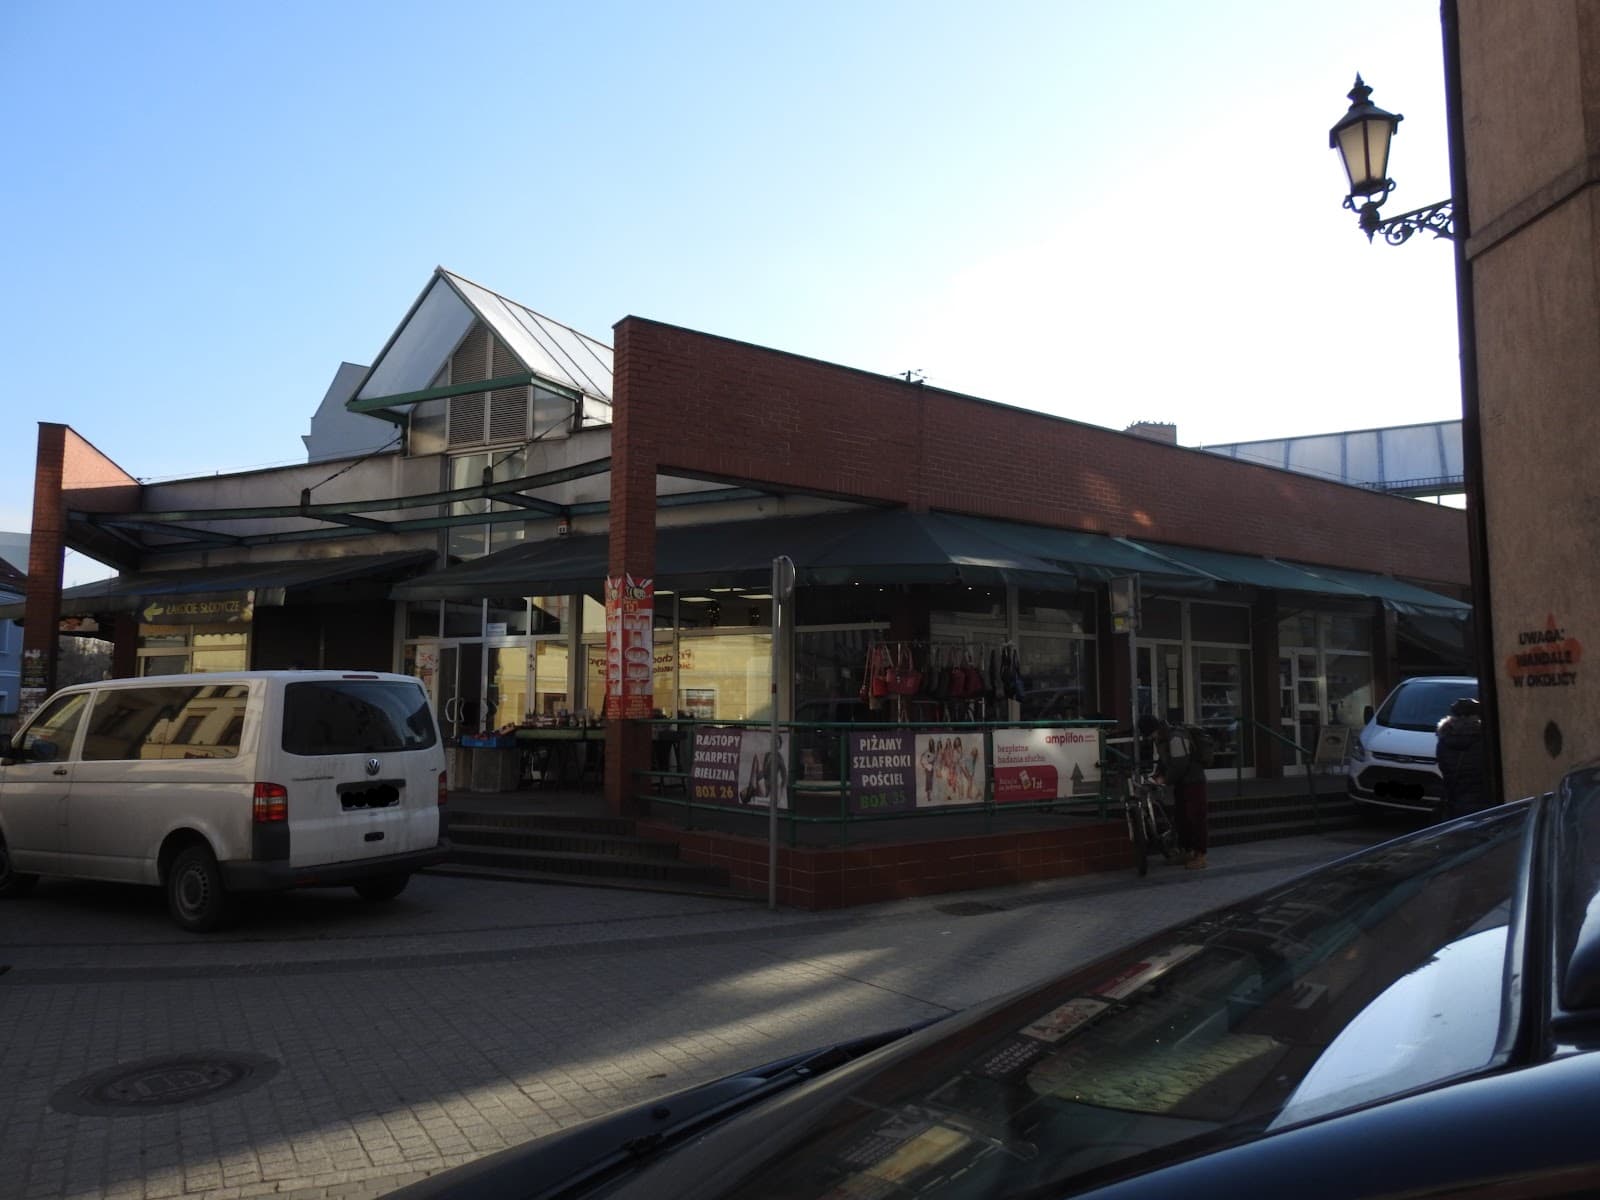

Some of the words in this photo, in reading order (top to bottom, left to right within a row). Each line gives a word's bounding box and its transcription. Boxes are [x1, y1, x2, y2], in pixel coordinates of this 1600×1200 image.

[624, 614, 651, 696] MIODY
[1513, 675, 1524, 688] W
[1527, 671, 1577, 687] OKOLICY
[696, 734, 741, 747] RAJSTOPY
[859, 734, 902, 752] PIŻAMY
[1045, 732, 1084, 748] amplifon
[694, 750, 738, 764] SKARPETY
[852, 754, 911, 769] SZLAFROKI
[694, 767, 736, 781] BIELIZNA
[861, 770, 905, 787] POŚCIEL
[695, 785, 717, 799] BOX
[720, 786, 734, 800] 26
[859, 792, 889, 809] BOX
